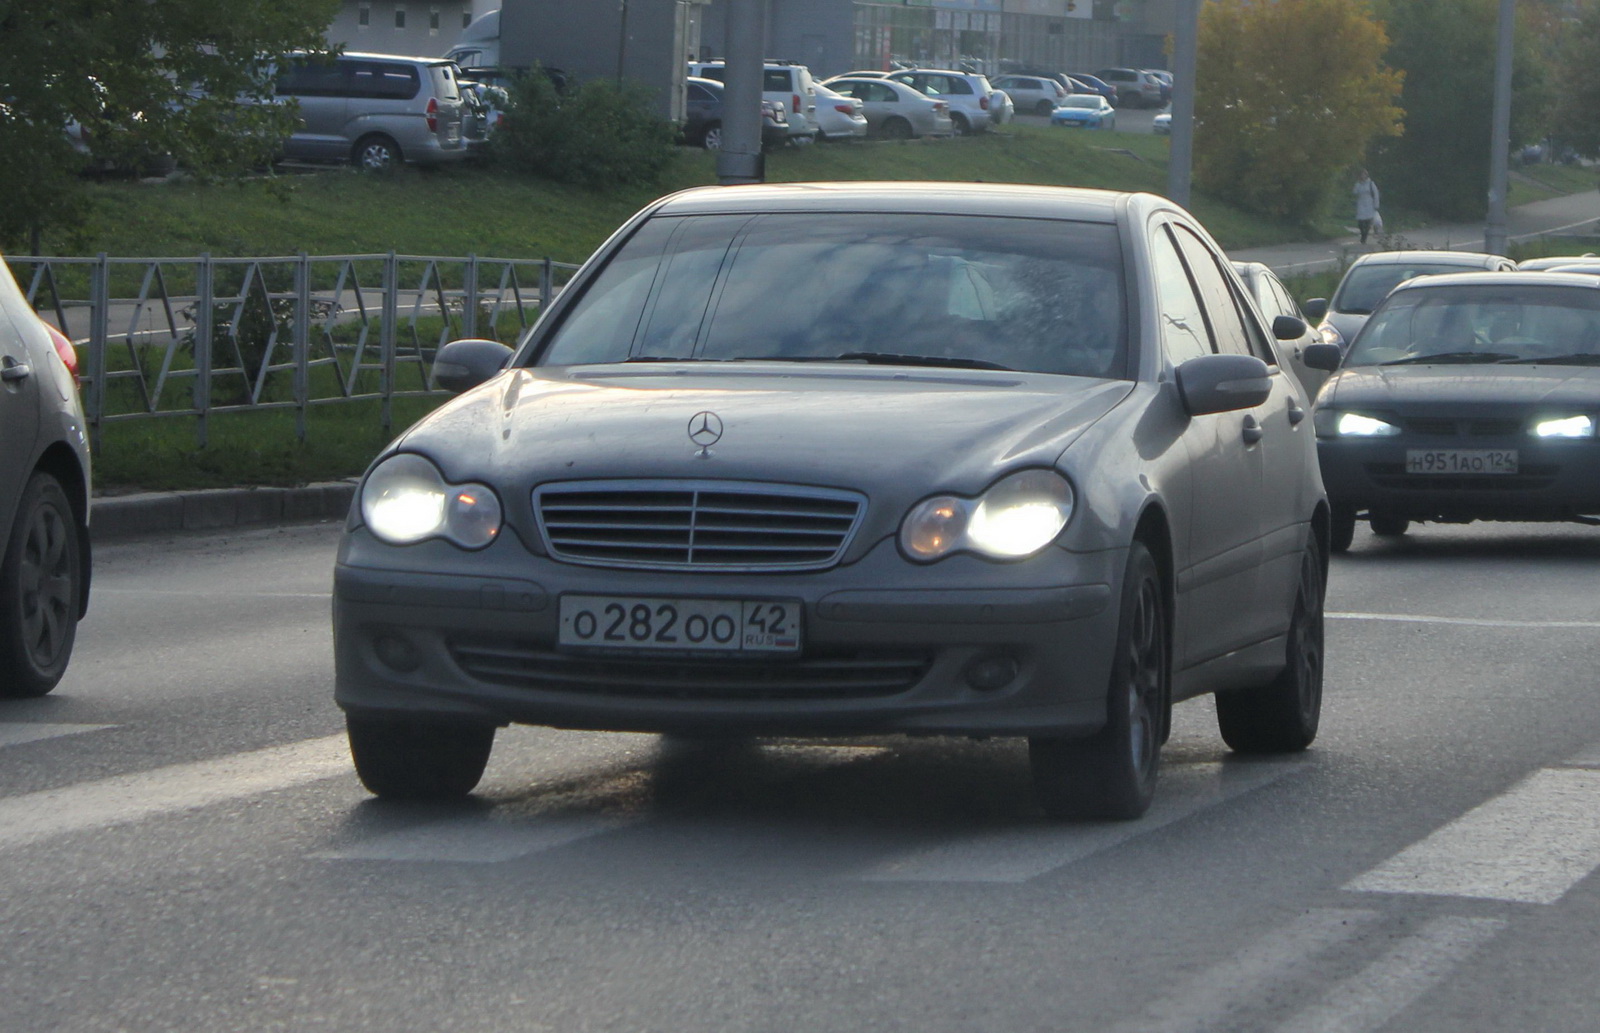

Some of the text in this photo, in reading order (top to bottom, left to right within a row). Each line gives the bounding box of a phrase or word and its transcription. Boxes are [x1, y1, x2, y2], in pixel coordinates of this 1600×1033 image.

[1487, 452, 1514, 467] 124
[748, 604, 787, 635] 42
[745, 634, 774, 646] RUS
